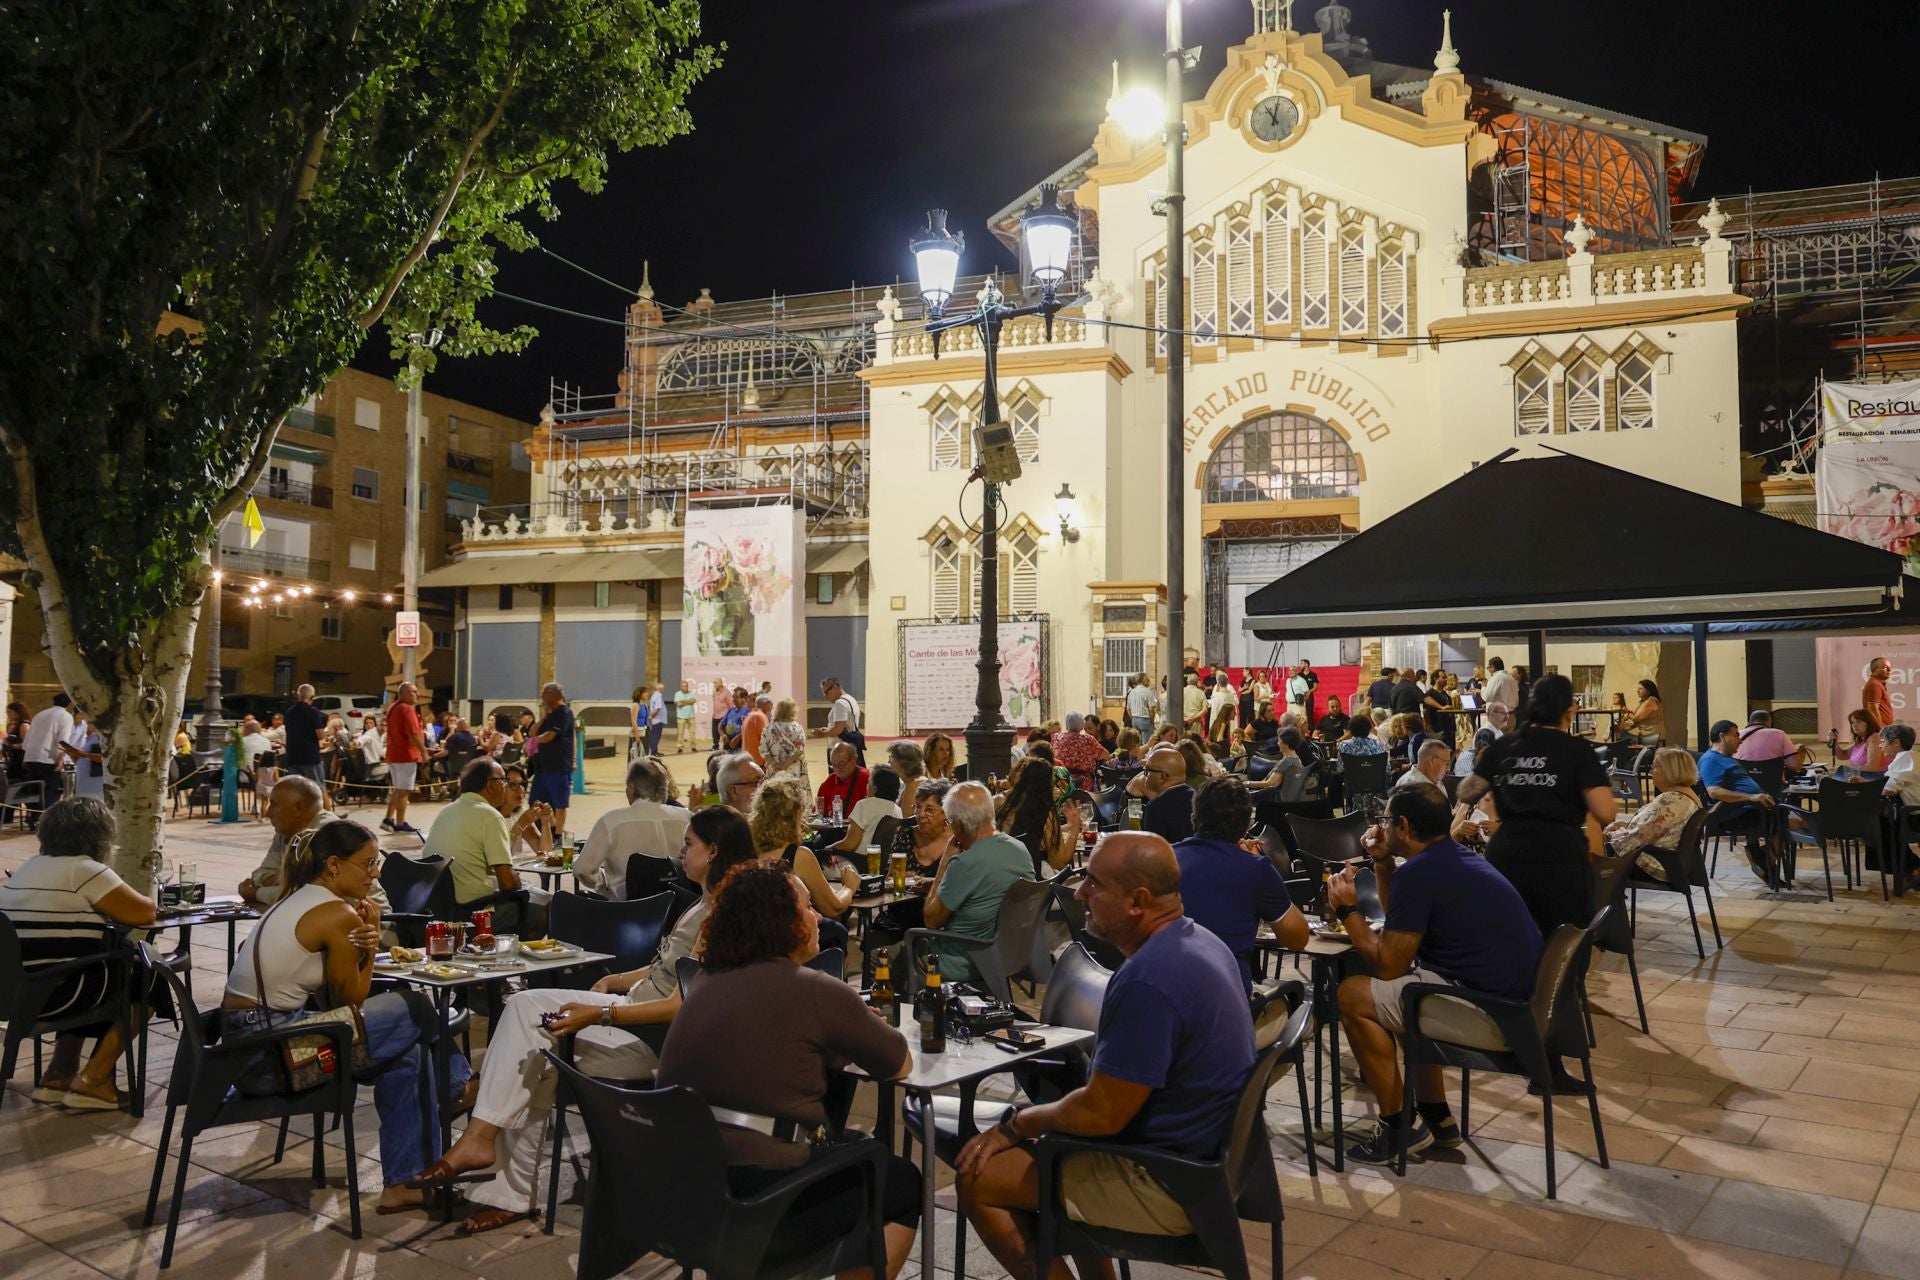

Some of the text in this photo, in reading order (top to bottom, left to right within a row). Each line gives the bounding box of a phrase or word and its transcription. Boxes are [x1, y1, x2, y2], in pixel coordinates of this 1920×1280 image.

[1289, 367, 1391, 443] PÚBLICO
[908, 649, 935, 658] Cante
[937, 649, 949, 657] de
[950, 648, 963, 657] las
